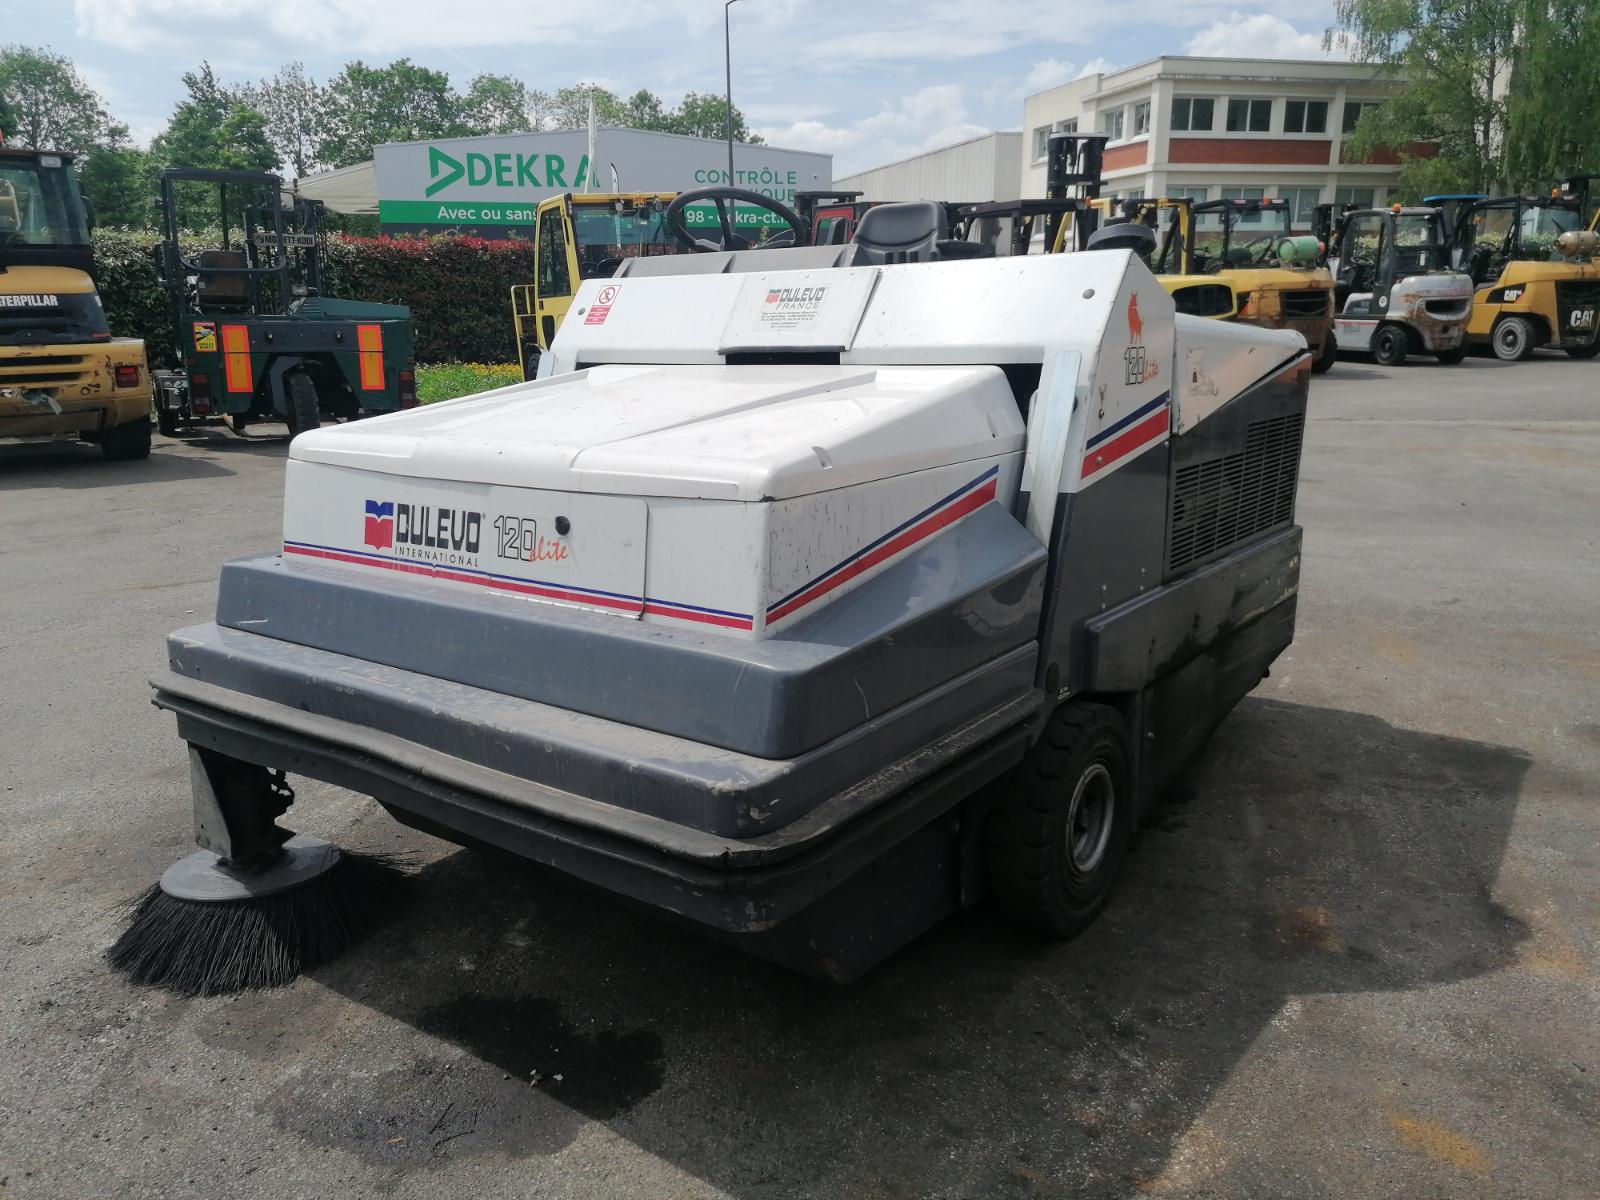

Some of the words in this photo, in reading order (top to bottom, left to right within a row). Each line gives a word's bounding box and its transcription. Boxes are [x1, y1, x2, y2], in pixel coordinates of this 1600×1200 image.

[466, 152, 601, 188] DEKRA
[694, 166, 797, 185] CONTRÔLE
[437, 205, 476, 220] Avec
[481, 209, 502, 220] ou
[686, 210, 705, 223] 98
[779, 286, 826, 302] DULEVO
[776, 302, 821, 310] FRANCE
[1570, 309, 1595, 327] CAT
[1123, 346, 1146, 386] 120
[395, 503, 481, 553] DULEVO
[493, 514, 538, 562] 120
[529, 535, 569, 562] elite
[394, 545, 480, 568] INTERNATIONAL
